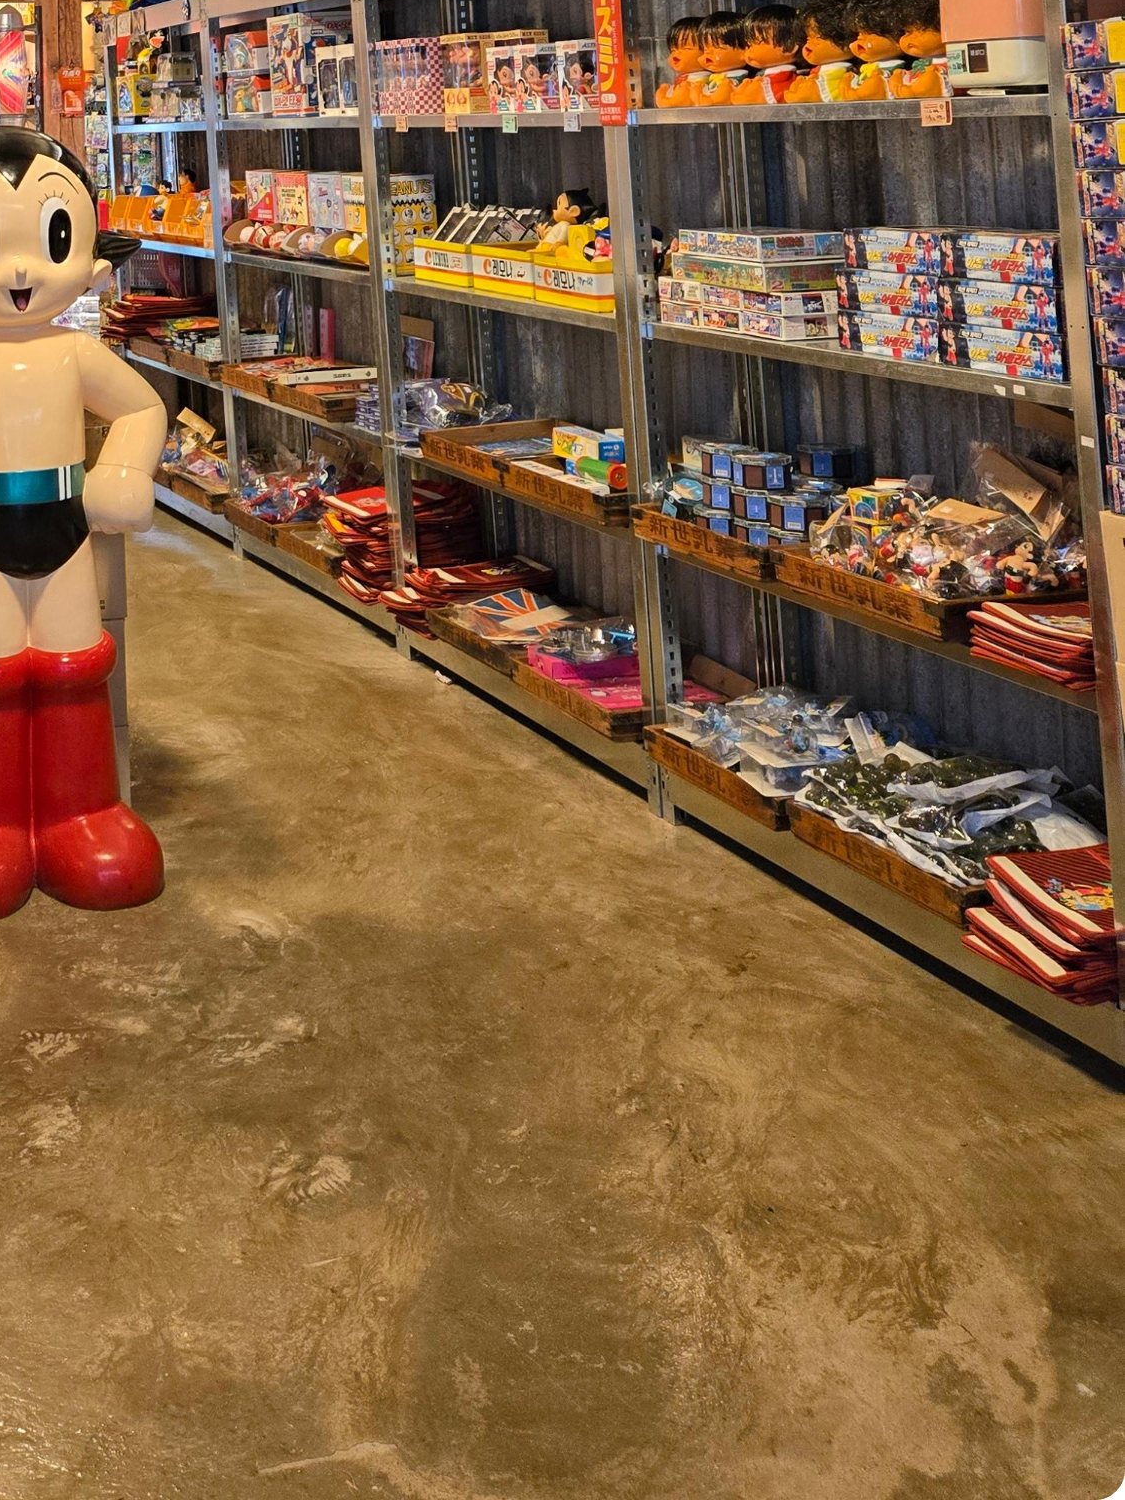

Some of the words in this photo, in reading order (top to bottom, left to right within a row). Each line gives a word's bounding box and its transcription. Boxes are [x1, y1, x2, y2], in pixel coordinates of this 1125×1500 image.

[389, 180, 433, 196] EANUTS
[492, 258, 514, 279] 레모나
[553, 268, 577, 290] 레모나
